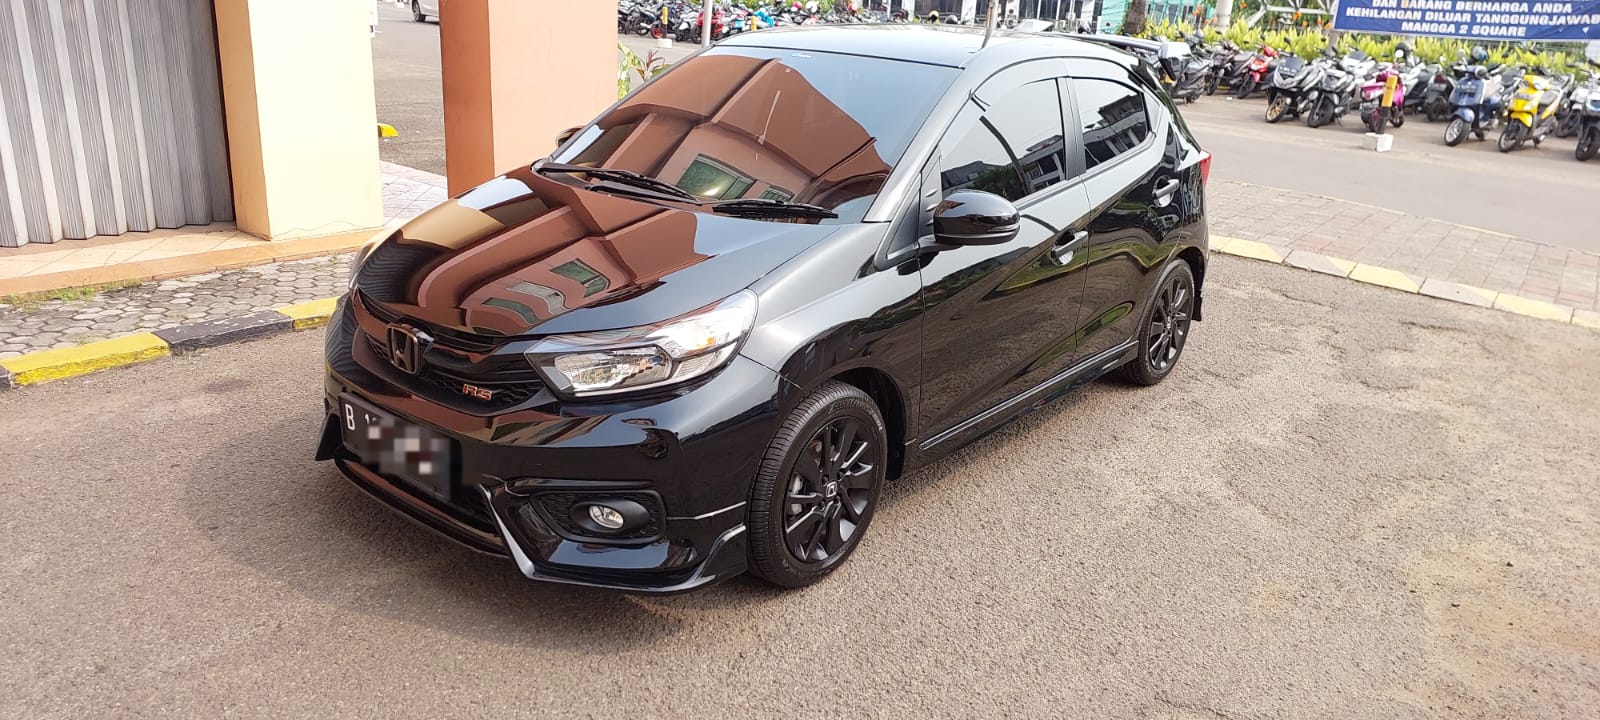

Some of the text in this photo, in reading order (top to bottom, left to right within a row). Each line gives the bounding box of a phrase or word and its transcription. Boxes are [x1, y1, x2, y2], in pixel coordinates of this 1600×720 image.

[1372, 0, 1573, 14] DAN BARANG BERHARGA ANDA
[1345, 7, 1600, 25] KEHILANGAN DILUAR TANGGUNGJAWAB
[1401, 21, 1527, 37] MANGGA 2 SQUARE
[463, 383, 493, 400] RS
[345, 403, 355, 430] B
